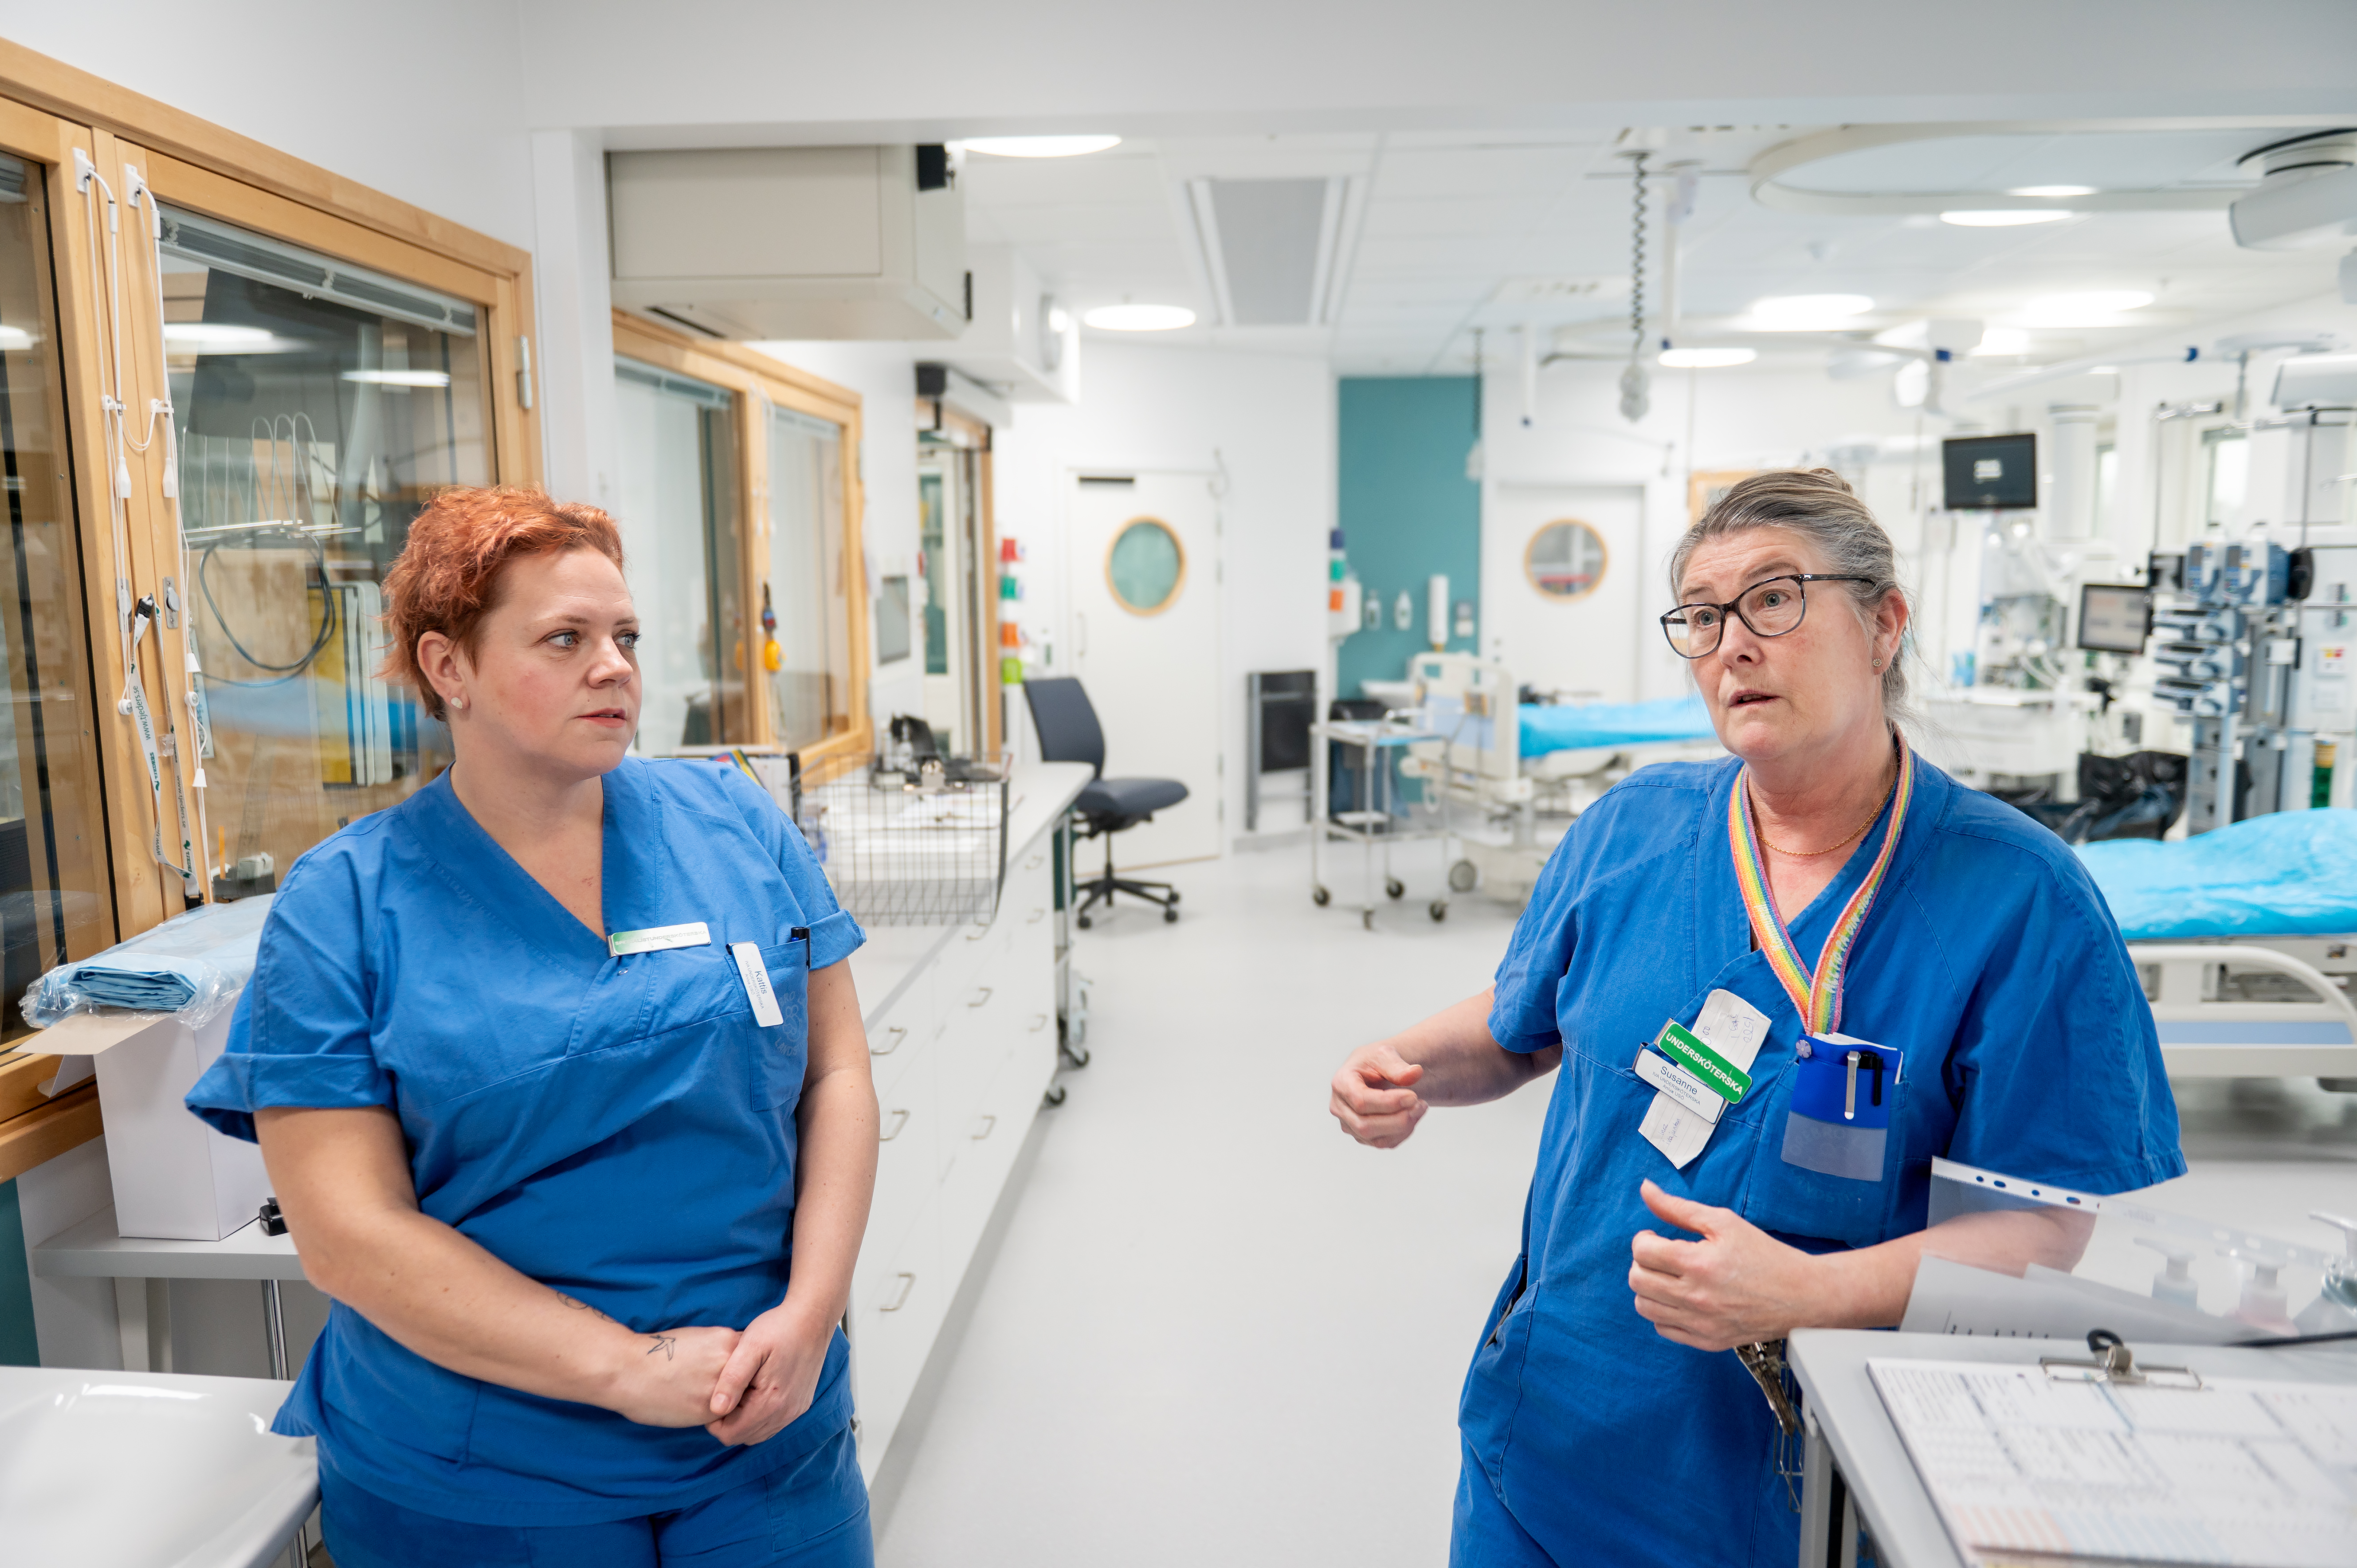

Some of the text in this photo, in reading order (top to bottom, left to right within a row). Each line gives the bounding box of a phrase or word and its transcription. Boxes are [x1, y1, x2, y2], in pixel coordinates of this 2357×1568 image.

[135, 685, 151, 741] www.tjeders.se
[177, 775, 187, 828] www.tjeders.se
[748, 968, 765, 1009] UNDERSKÖTERSKA
[754, 971, 767, 994] Kattis
[1660, 1066, 1698, 1095] Susanne
[1666, 1032, 1743, 1095] UNDERSKÖTERSKA
[1660, 1076, 1701, 1105] UNDERSKÖTERSKA
